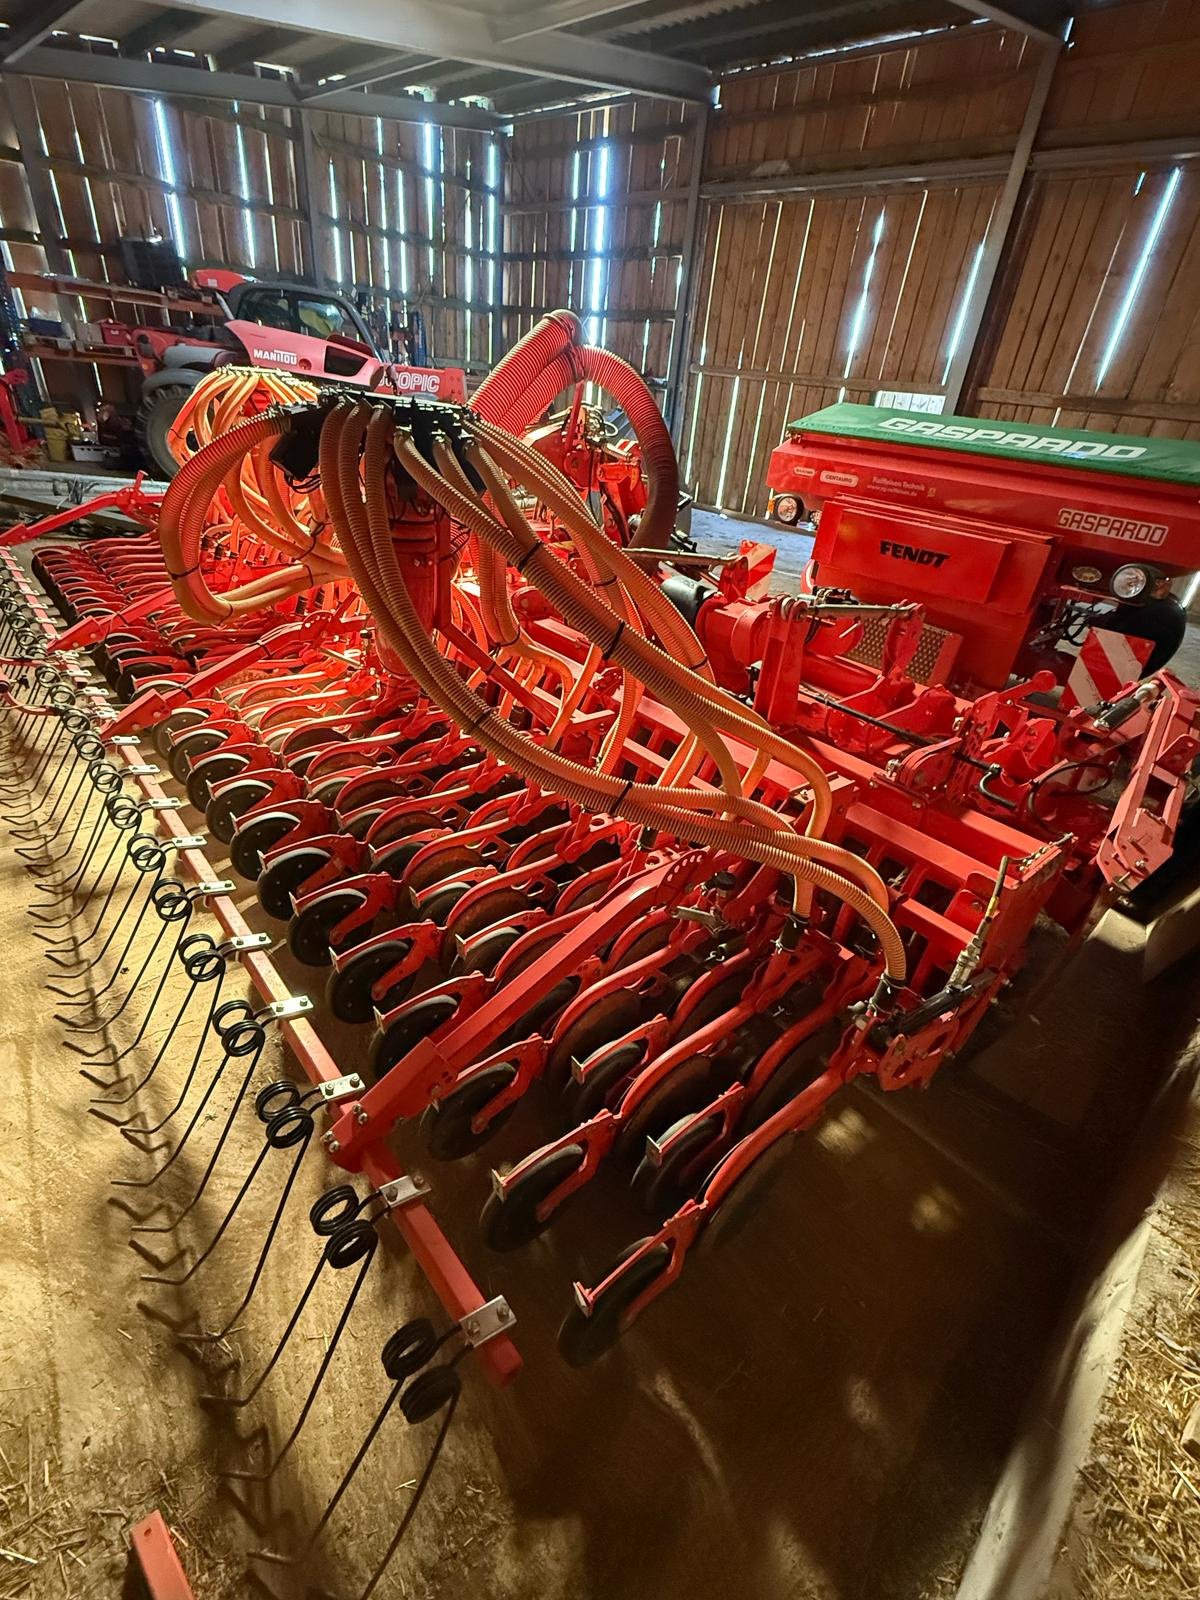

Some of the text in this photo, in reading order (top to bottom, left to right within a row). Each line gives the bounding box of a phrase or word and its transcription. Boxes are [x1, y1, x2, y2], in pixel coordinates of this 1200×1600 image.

[253, 348, 298, 365] MANITOU
[877, 416, 1148, 460] GASPARDO
[1057, 508, 1168, 546] GASPARDO
[879, 539, 951, 569] FENDT
